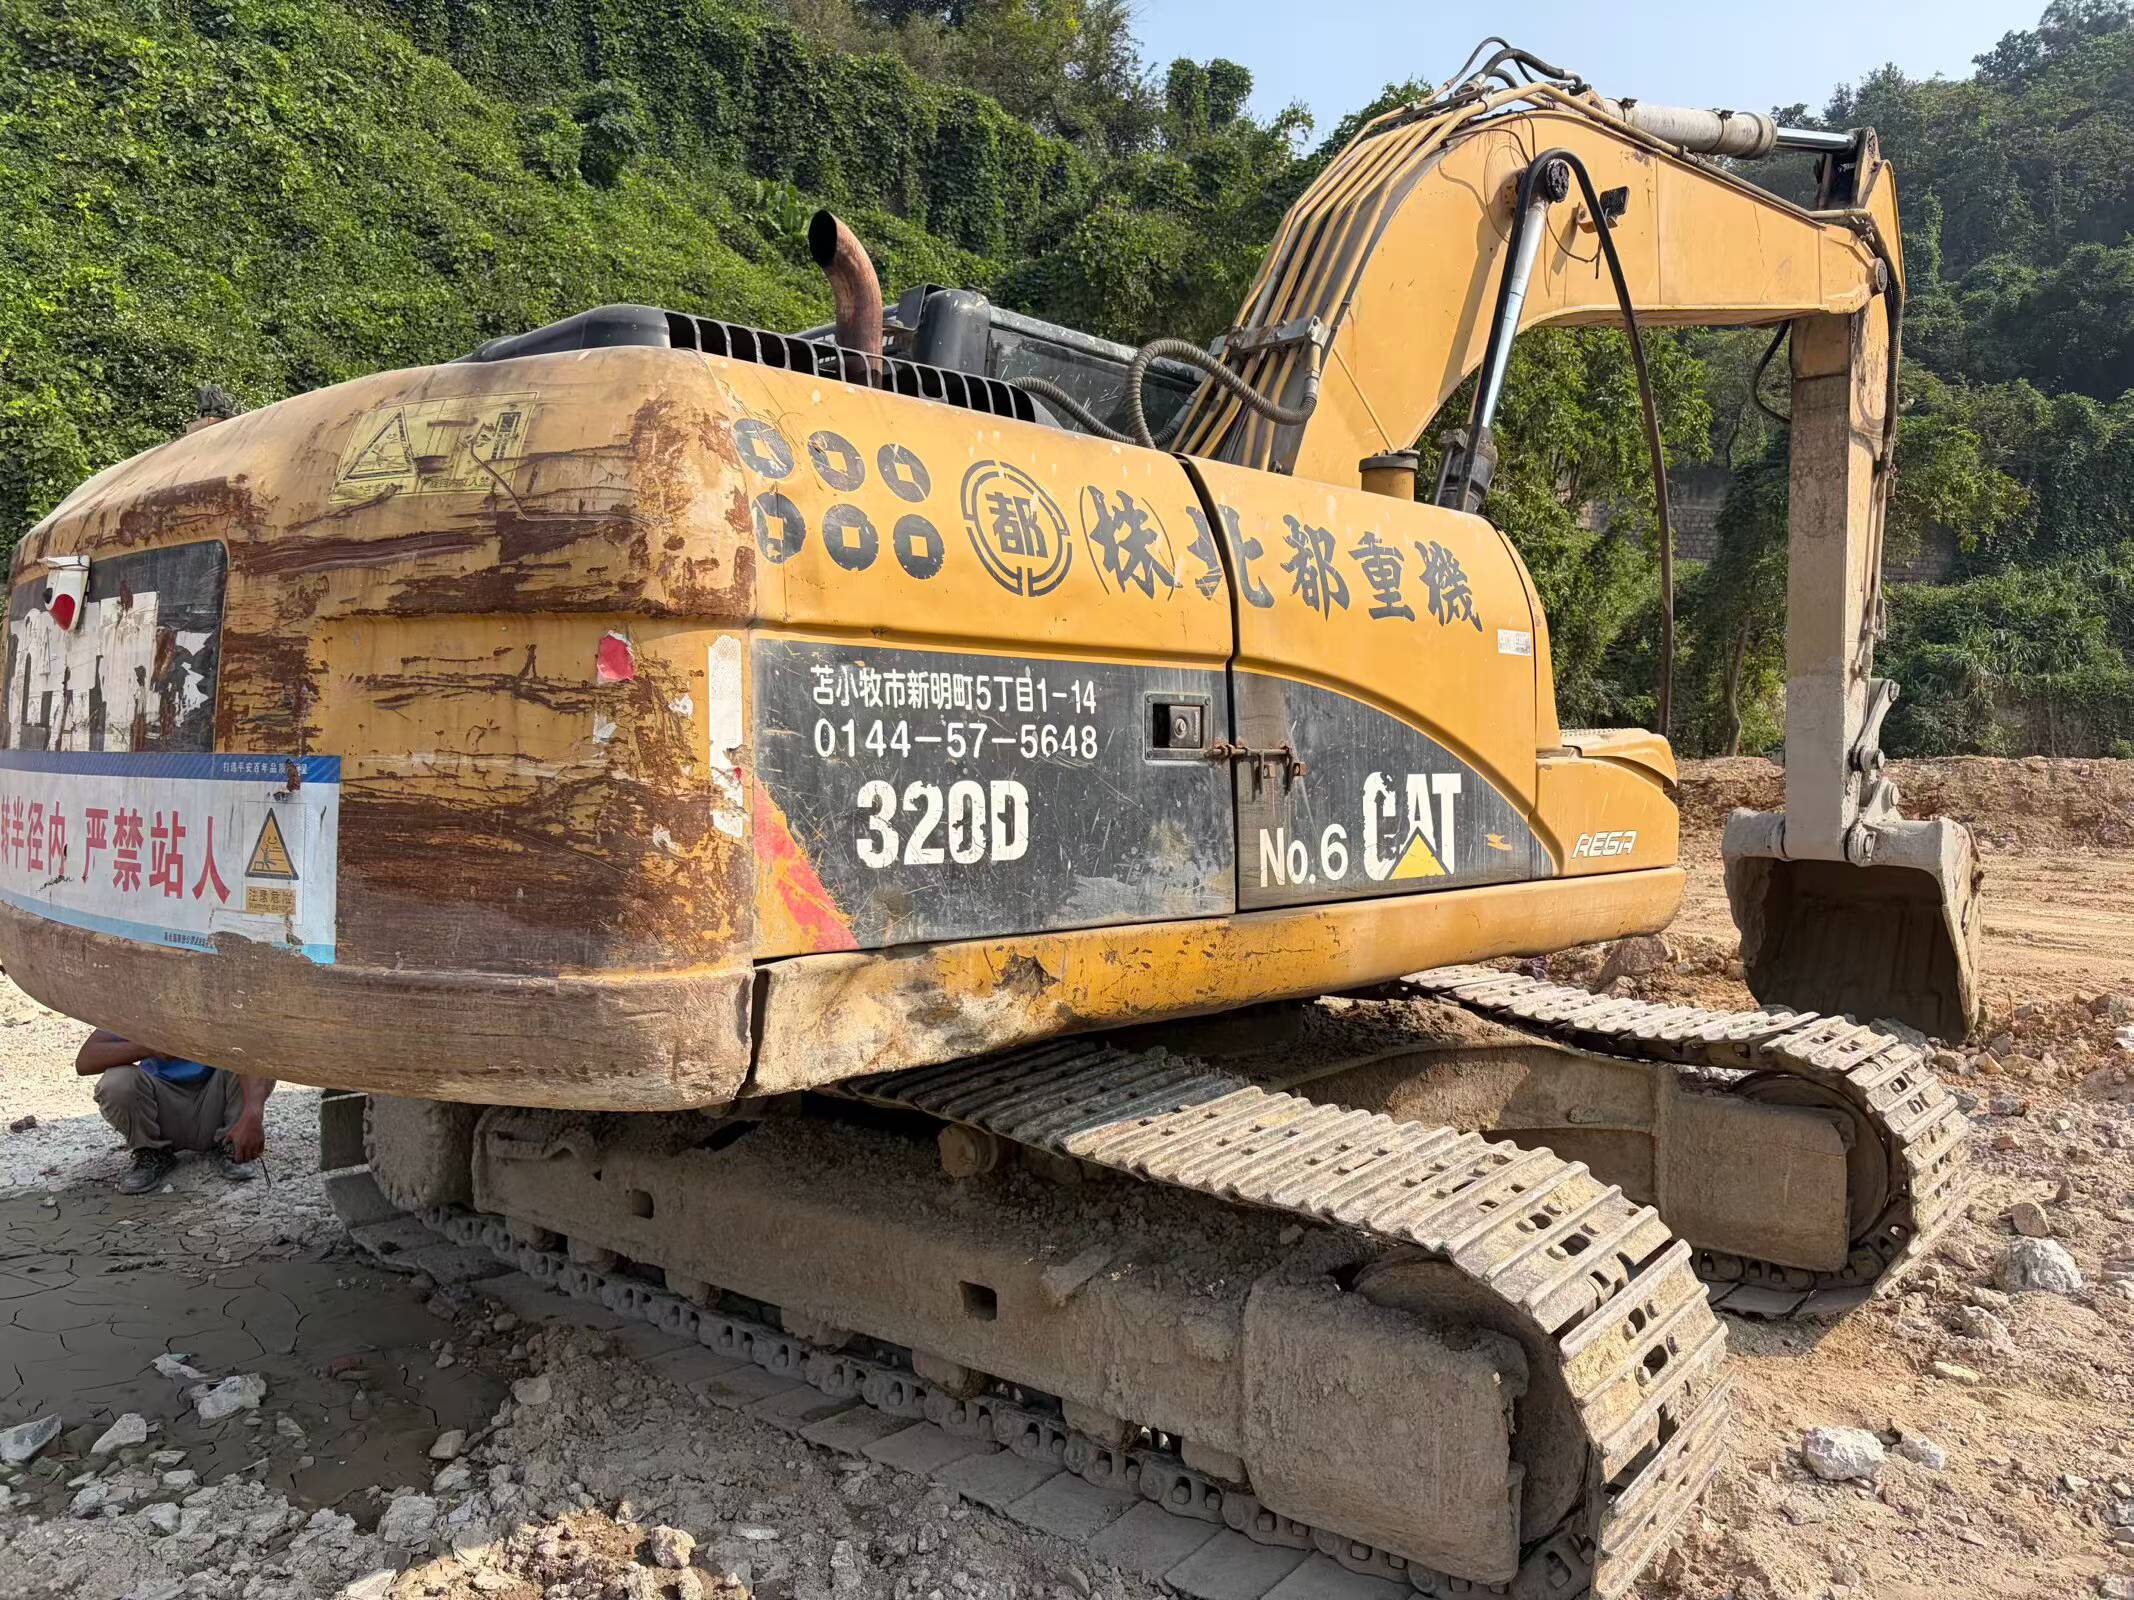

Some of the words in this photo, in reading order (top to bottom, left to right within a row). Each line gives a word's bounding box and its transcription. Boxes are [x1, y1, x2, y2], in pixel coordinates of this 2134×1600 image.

[810, 664, 1097, 714] 苫小牧市新明町5丁目1-14
[814, 717, 1098, 760] 0144-57-5648
[82, 807, 231, 904] 严禁站人
[856, 779, 1029, 869] 320D
[1363, 771, 1461, 881] CAT
